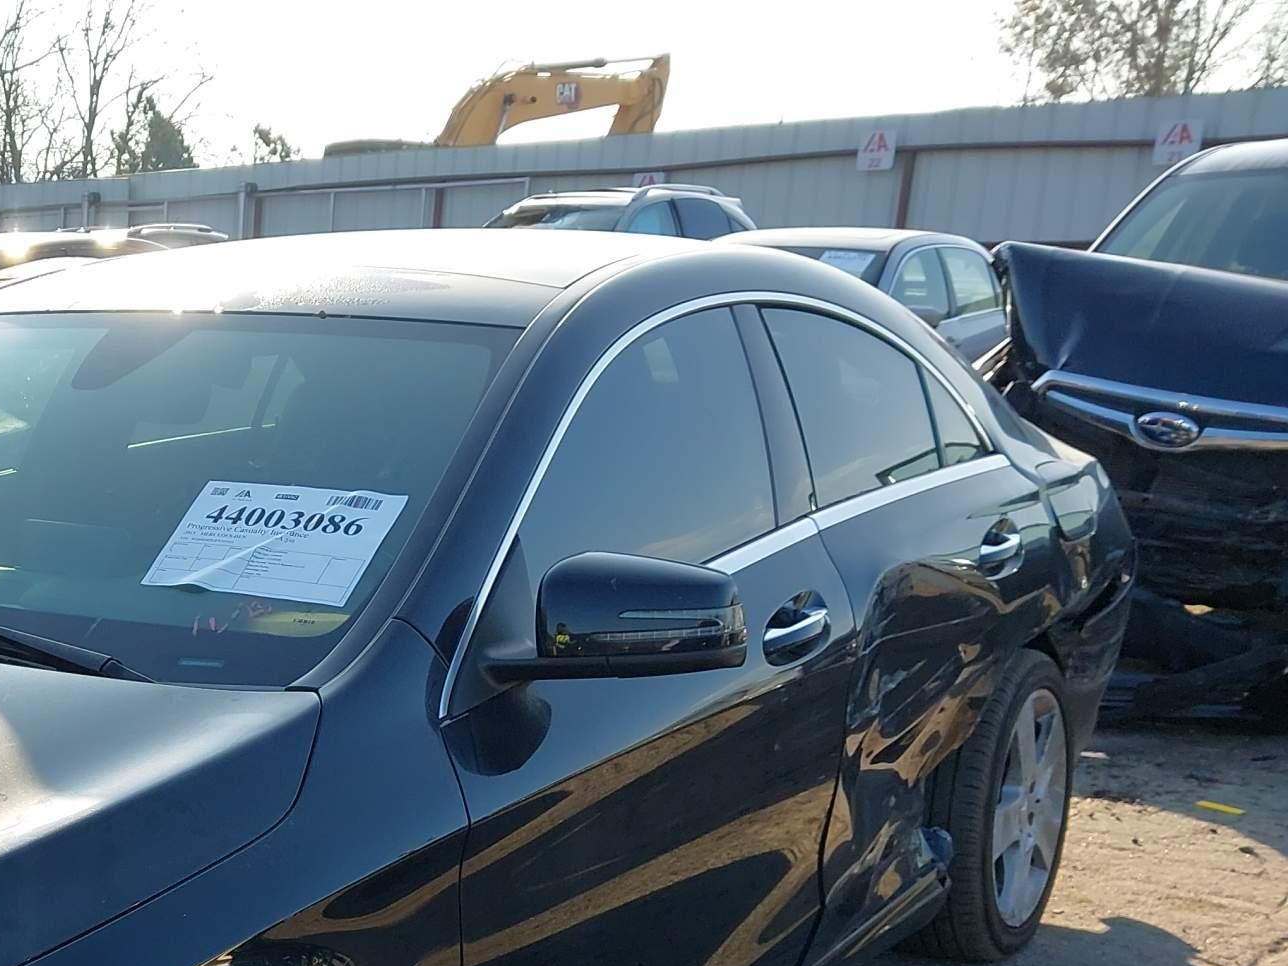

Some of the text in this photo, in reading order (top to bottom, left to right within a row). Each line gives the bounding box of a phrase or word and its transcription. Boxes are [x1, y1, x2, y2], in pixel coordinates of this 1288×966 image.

[556, 83, 576, 103] CAT
[186, 522, 233, 532] Progressive
[234, 525, 266, 536] Casualty
[206, 504, 370, 537] 44003086
